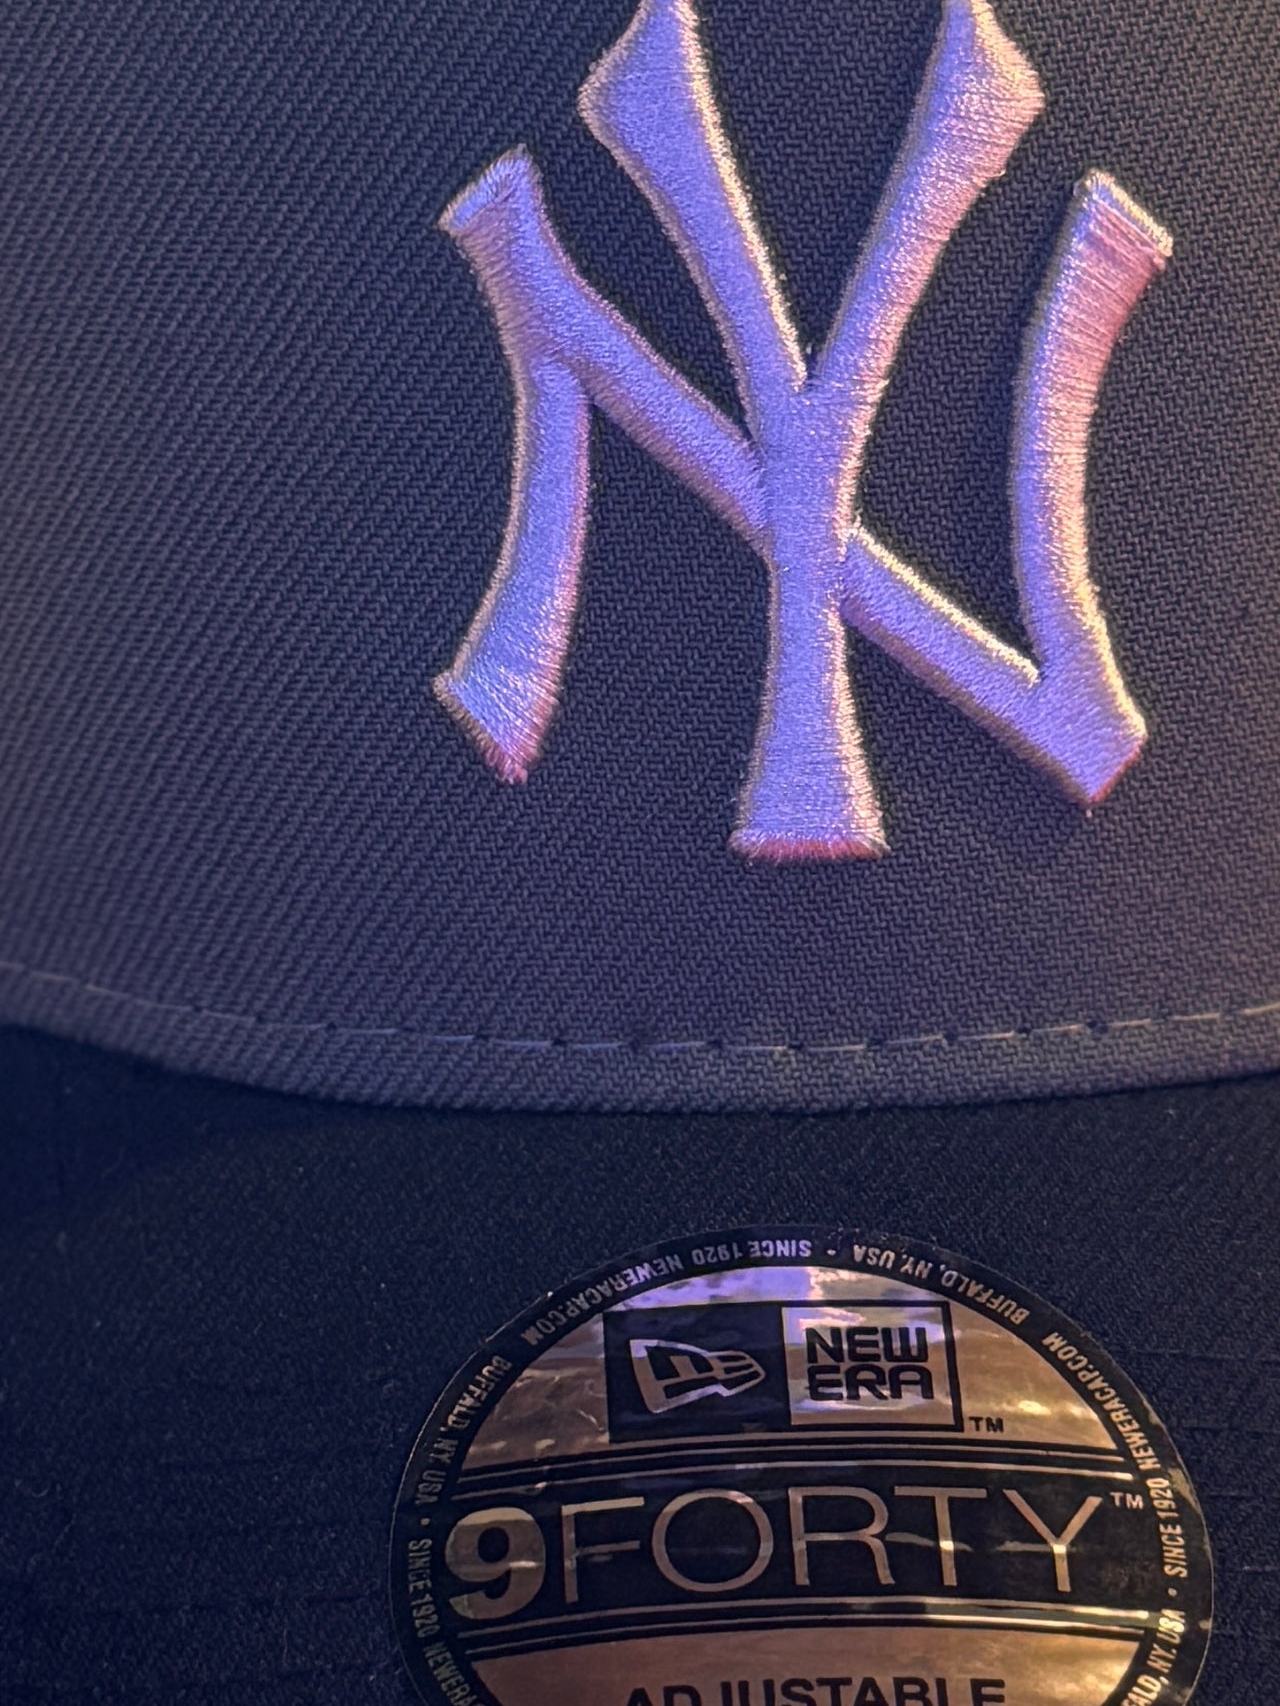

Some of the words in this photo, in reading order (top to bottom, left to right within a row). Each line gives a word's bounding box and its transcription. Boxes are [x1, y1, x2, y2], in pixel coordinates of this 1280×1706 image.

[691, 1245, 744, 1266] 1920
[748, 1239, 813, 1258] SINCE
[853, 1244, 897, 1270] USA
[520, 1254, 686, 1346] NEWERACAP.COM
[805, 1326, 930, 1364] NEW
[808, 1363, 935, 1401] ERA
[1042, 1331, 1162, 1471] NEWERACAP.COM
[969, 1416, 1004, 1433] TM
[415, 1469, 446, 1506] USA
[1110, 1491, 1145, 1510] TM
[1146, 1477, 1180, 1519] 1920
[407, 1538, 433, 1593] SINCE
[444, 1485, 1104, 1621] 9FORTY
[1159, 1524, 1188, 1579] SINCE
[410, 1593, 440, 1639] 1920
[1157, 1606, 1187, 1644] USA
